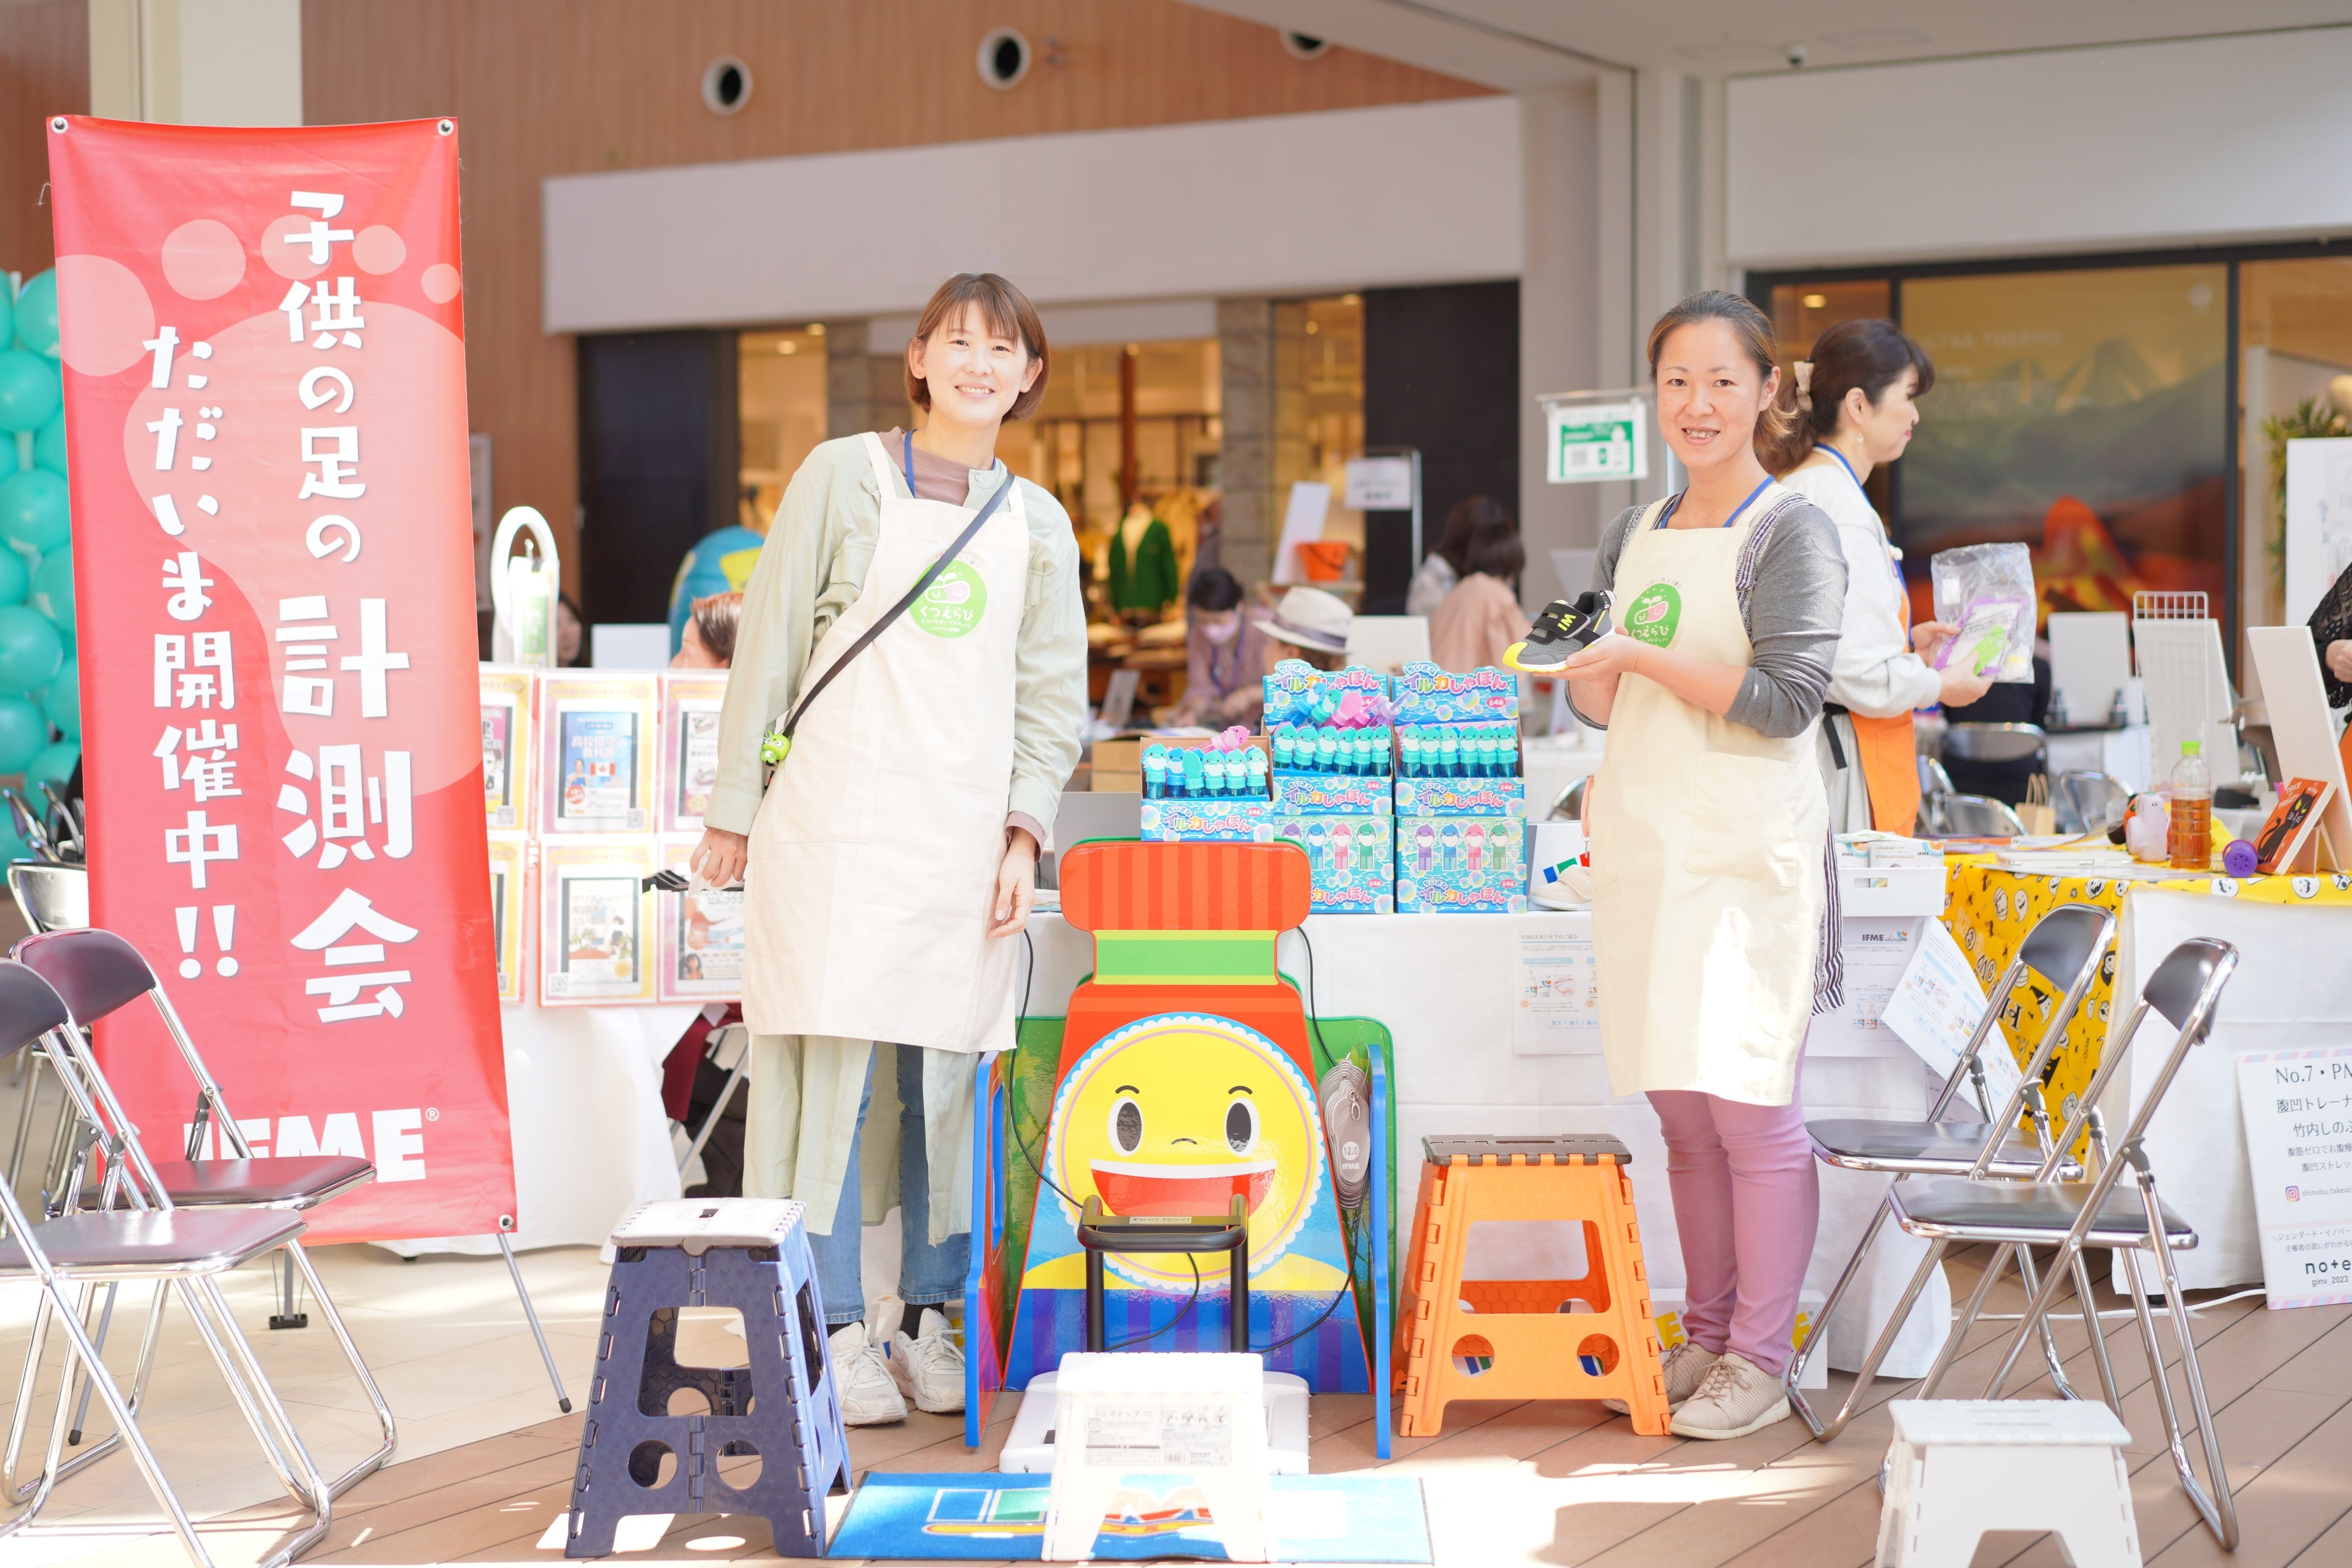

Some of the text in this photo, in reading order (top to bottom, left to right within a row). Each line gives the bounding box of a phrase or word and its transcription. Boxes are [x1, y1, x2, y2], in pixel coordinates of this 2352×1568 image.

[276, 190, 419, 1023] 子供の足の計測会
[920, 605, 974, 622] くつえらび
[1631, 625, 1669, 639] くつえらび
[1279, 664, 1309, 675] ちいさな
[1406, 665, 1438, 675] ちいさな
[1403, 670, 1508, 694] イルカしゃぼん
[1287, 780, 1314, 792] ちいさな
[1420, 782, 1447, 793] ちいさな
[1285, 788, 1372, 807] イルカしゃぼん
[1417, 789, 1505, 809] イルカしゃぼん
[1166, 805, 1193, 817] ちいさな
[1162, 813, 1253, 833] イルカしゃぼん
[1422, 879, 1449, 890] ちいさな
[1311, 887, 1373, 905] カしゃぼん
[1420, 887, 1506, 906] イルカしゃぼん
[1343, 1146, 1358, 1155] 12.0
[2301, 1186, 2352, 1197] shinobu.takeuc
[2305, 1259, 2351, 1274] note
[2312, 1276, 2349, 1287] ginv_2023
